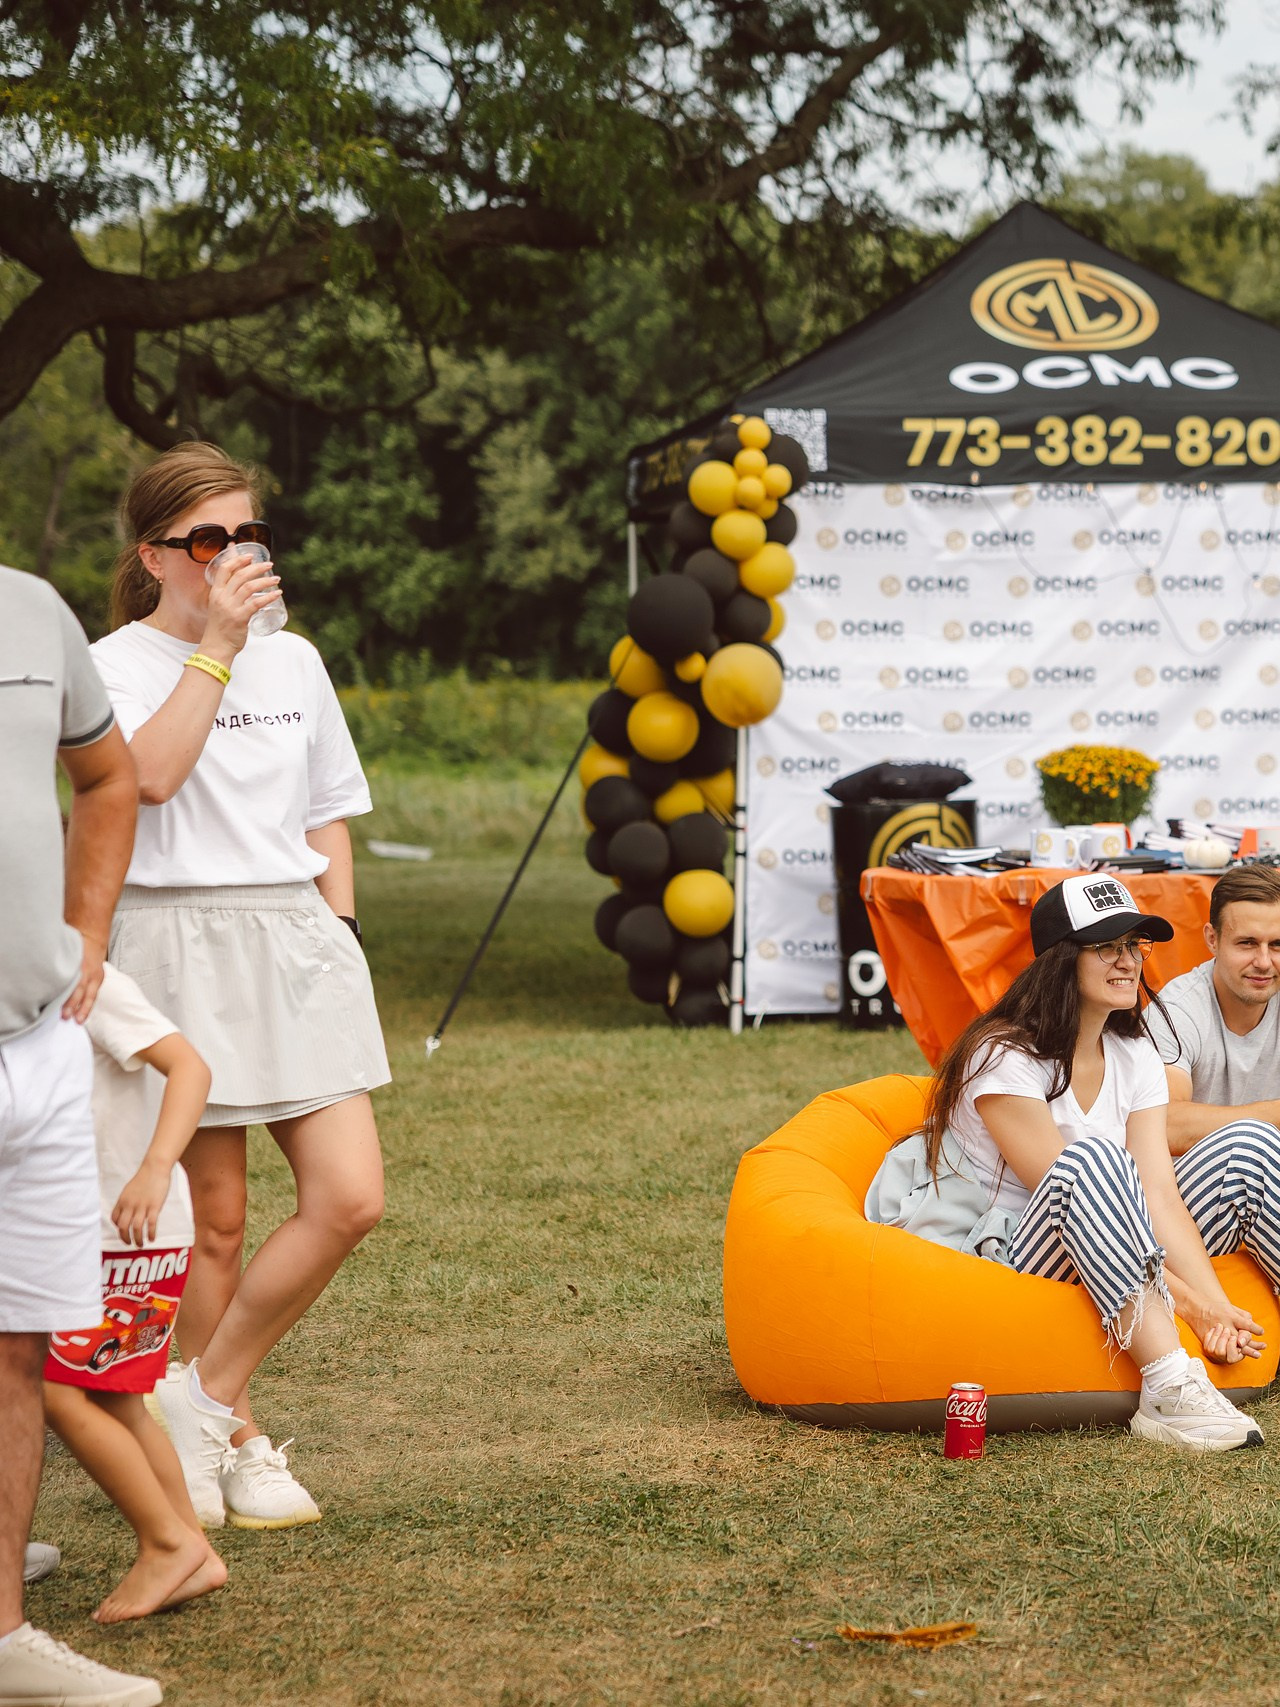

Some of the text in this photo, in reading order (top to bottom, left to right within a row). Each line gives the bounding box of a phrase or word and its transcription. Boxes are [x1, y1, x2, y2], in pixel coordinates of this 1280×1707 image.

[948, 353, 1240, 394] OCMC
[800, 484, 844, 499] CMC
[911, 489, 974, 502] OCMC
[844, 530, 908, 545] OCMC
[972, 530, 1034, 545] OCMC
[1100, 530, 1161, 543] OCMC
[795, 575, 841, 590] CMC
[907, 576, 969, 590] OCMC
[1034, 576, 1097, 590] OCMC
[1162, 576, 1224, 590] OCMC
[841, 620, 904, 635] OCMC
[969, 621, 1032, 636] OCMC
[1099, 621, 1158, 635] OCMC
[906, 667, 969, 681] OCMC
[1034, 666, 1096, 681] OCMC
[1161, 666, 1221, 680] OCMC
[842, 712, 904, 726] OCMC
[969, 712, 1031, 727] OCMC
[1097, 712, 1158, 725] OCMC
[781, 758, 841, 771] OCMC
[976, 803, 1032, 818] CMC
[1219, 799, 1280, 813] OCMC
[784, 850, 833, 863] OCM
[1087, 884, 1120, 899] WE
